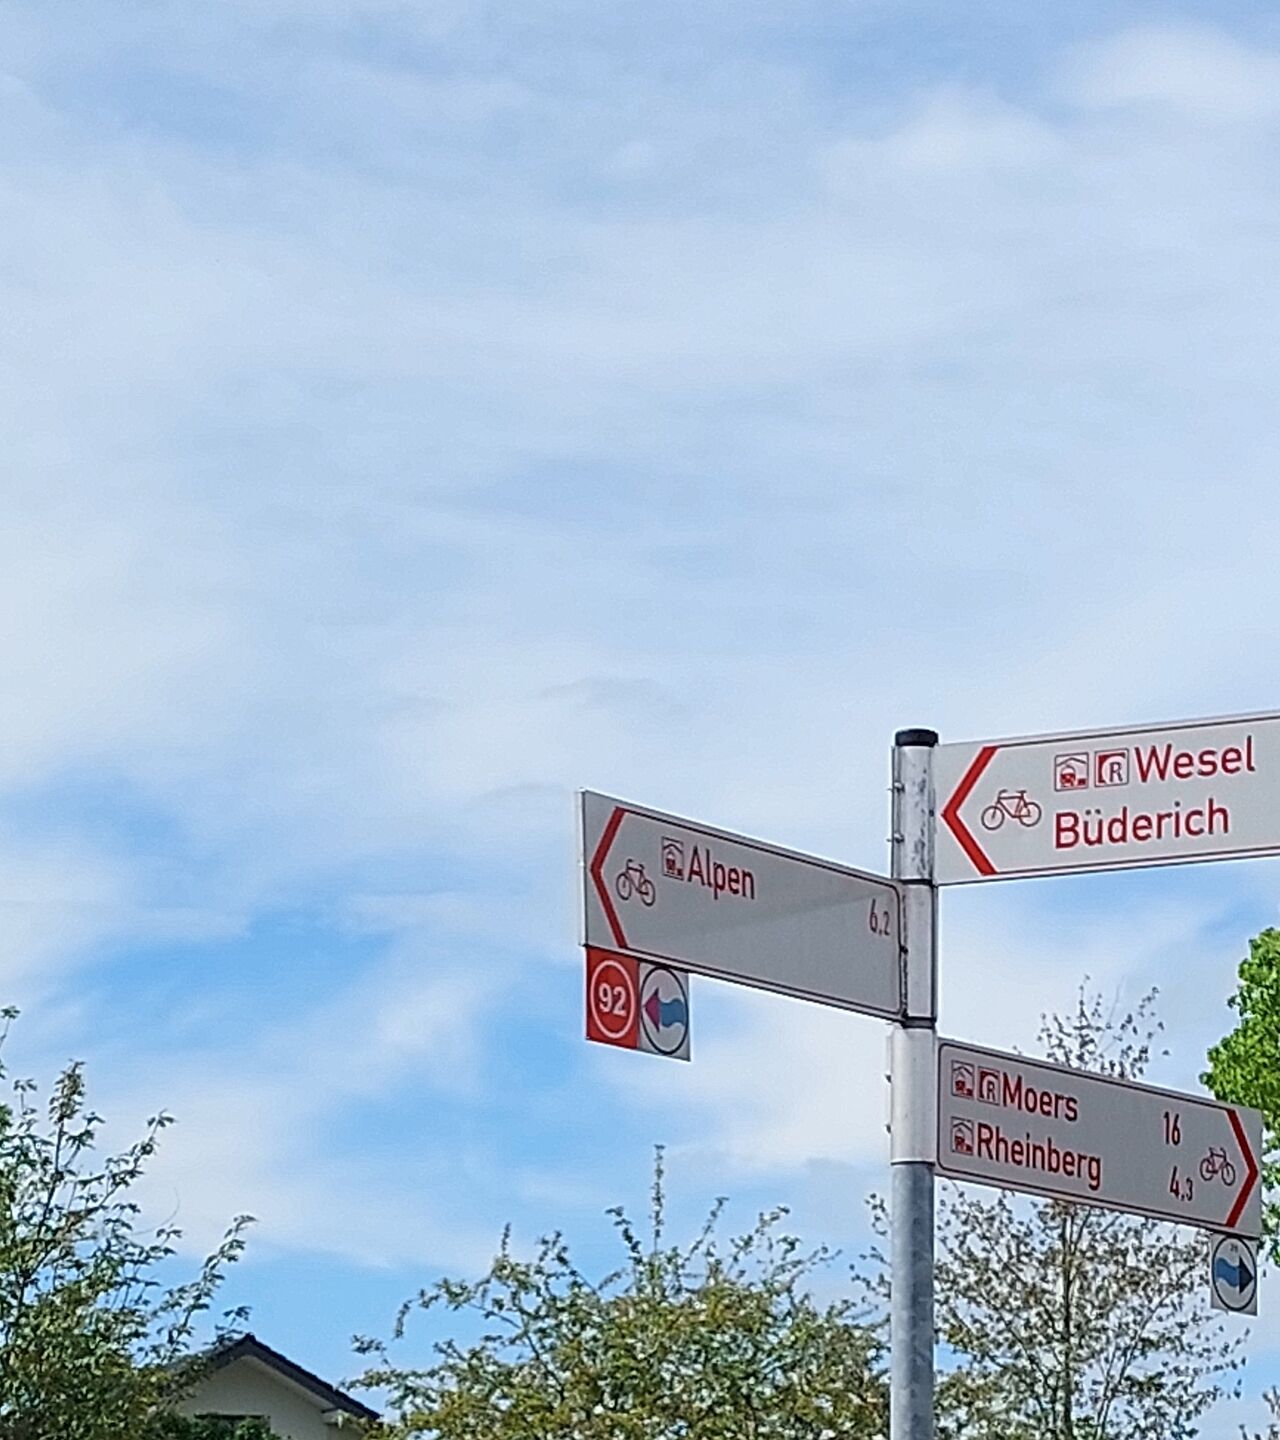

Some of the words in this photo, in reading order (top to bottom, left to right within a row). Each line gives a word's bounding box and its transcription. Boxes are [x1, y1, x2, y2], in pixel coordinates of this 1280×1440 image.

[1134, 734, 1256, 783] Wesel
[1053, 797, 1230, 850] Büderich
[687, 845, 756, 901] Alpen
[869, 898, 891, 937] 6,2
[598, 982, 627, 1018] 92
[1002, 1071, 1079, 1123] Moers
[1163, 1111, 1181, 1146] 16
[977, 1122, 1102, 1191] Rheinberg
[1169, 1166, 1194, 1201] 4,3
